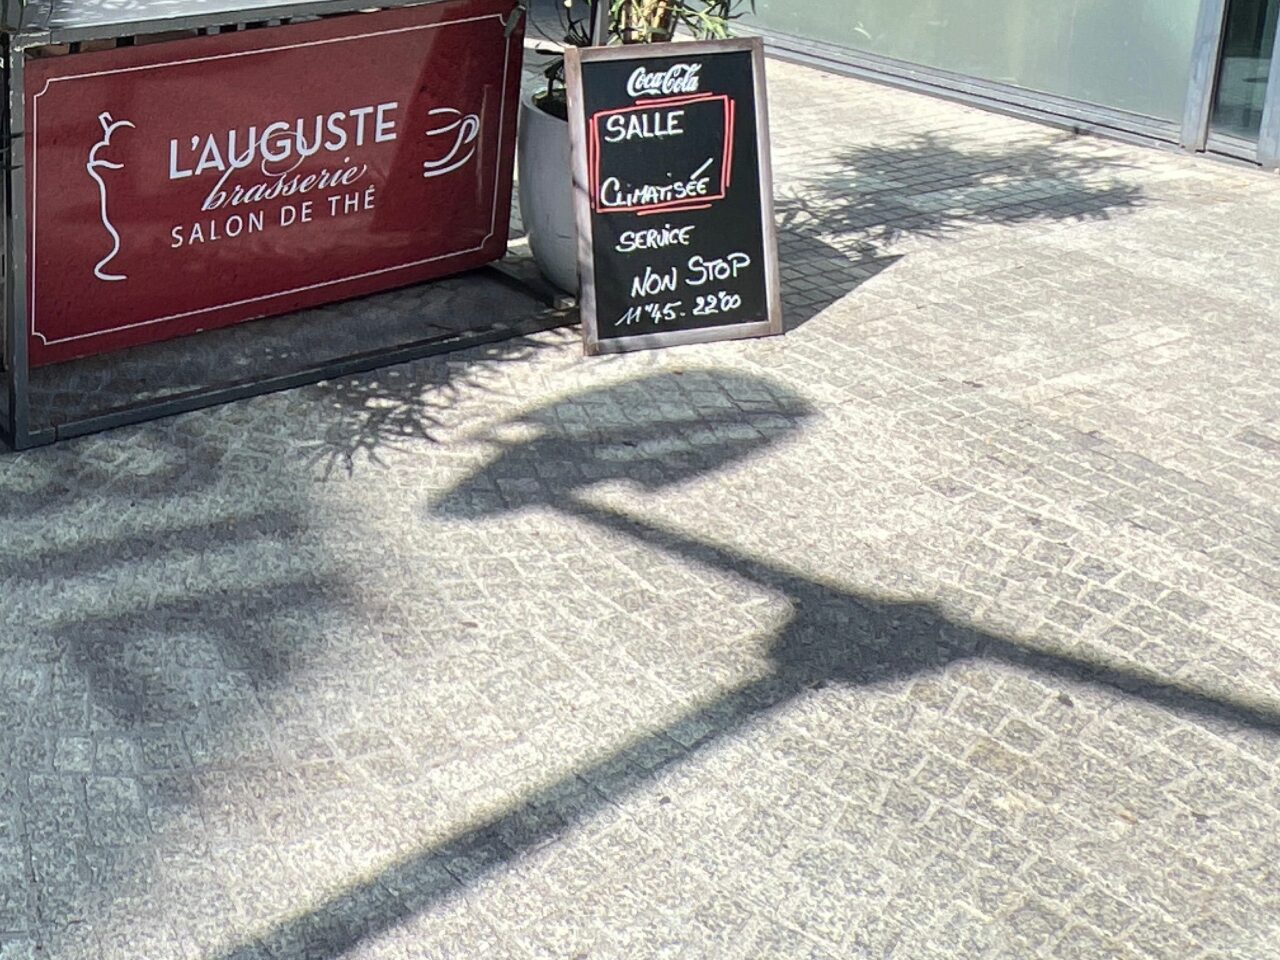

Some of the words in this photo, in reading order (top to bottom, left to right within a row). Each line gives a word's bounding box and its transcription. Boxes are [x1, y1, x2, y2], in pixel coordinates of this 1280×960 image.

[627, 63, 702, 97] Coca-Cola
[169, 101, 399, 181] L'AUGUSTE
[604, 110, 684, 143] SALLE
[201, 152, 368, 211] brasserie
[171, 211, 265, 249] SALON
[280, 200, 313, 227] DE
[328, 184, 377, 217] THÉ
[631, 265, 677, 298] NON
[685, 252, 751, 286] STOP
